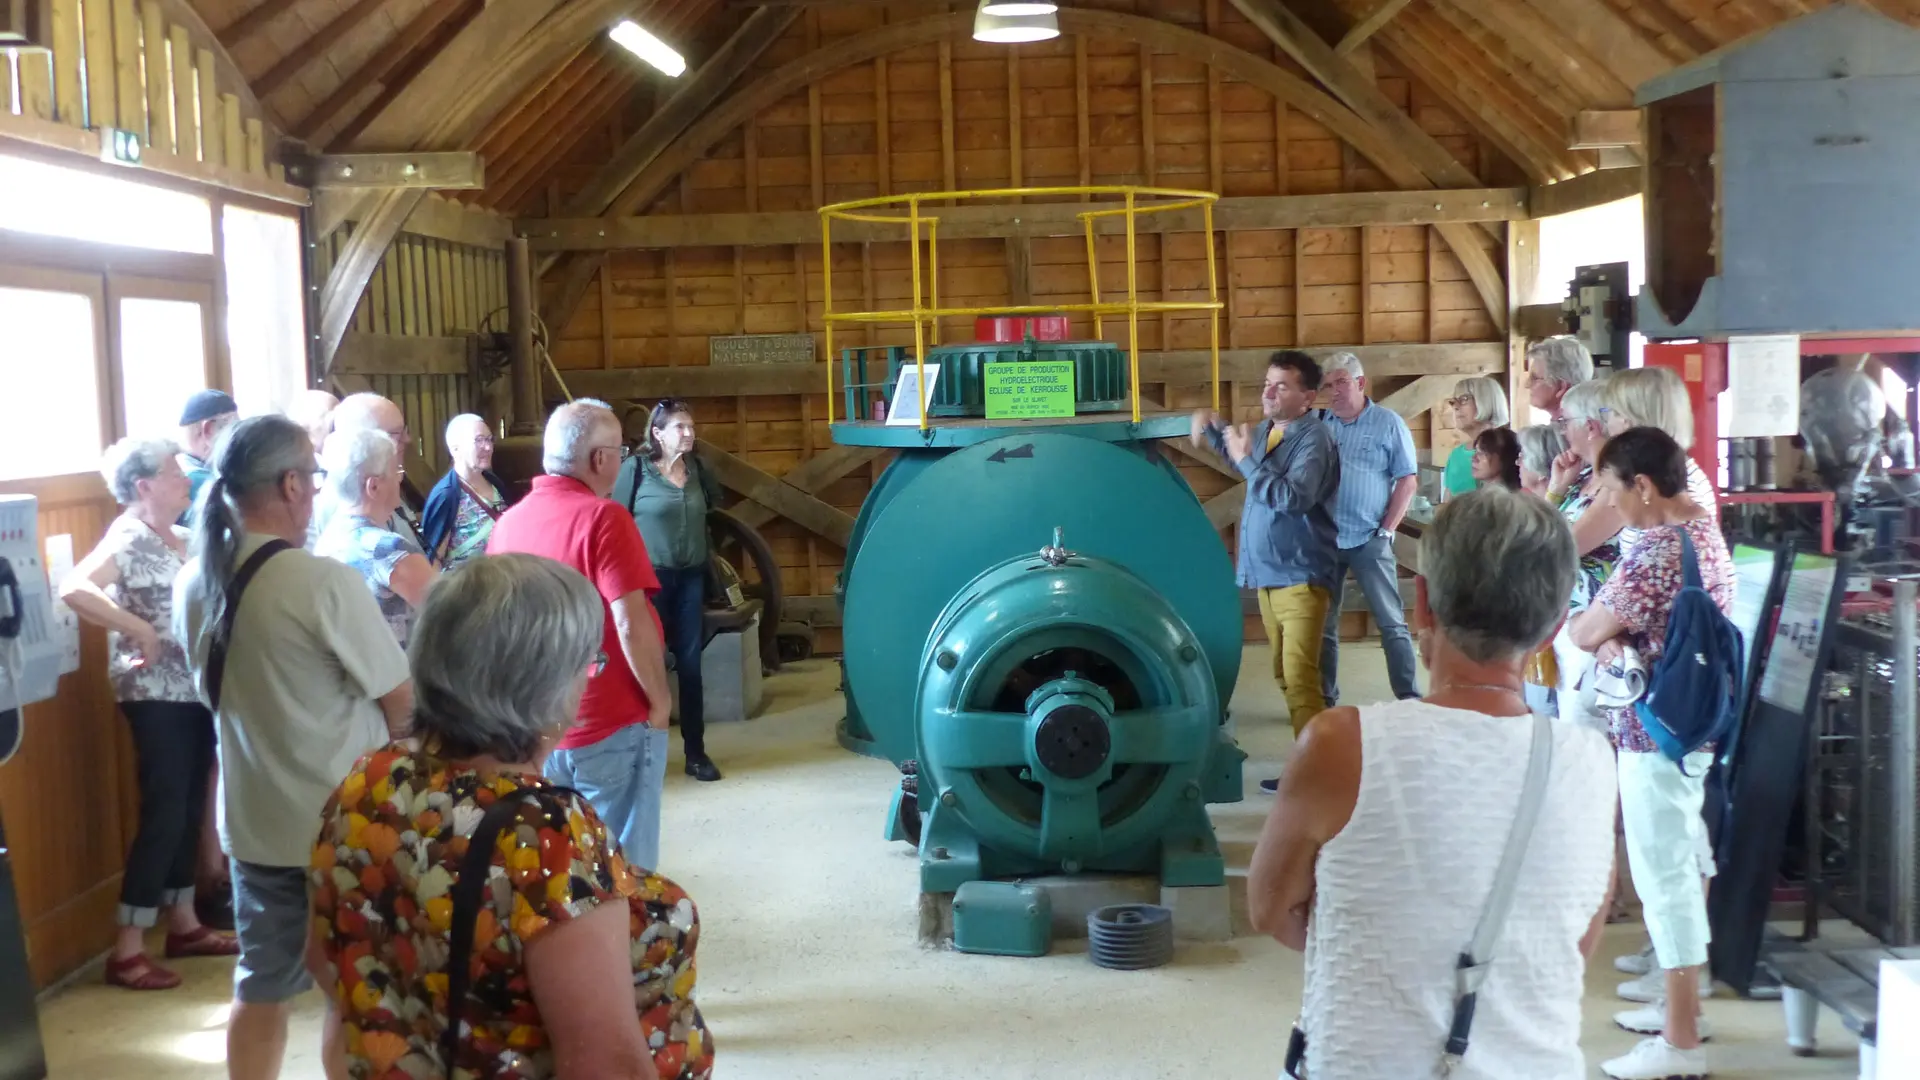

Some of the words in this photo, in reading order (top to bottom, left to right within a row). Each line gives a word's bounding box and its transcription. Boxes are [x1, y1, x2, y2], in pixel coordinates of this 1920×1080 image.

[714, 352, 757, 363] MAISON
[988, 366, 1013, 375] GROUPE
[1017, 366, 1026, 374] DE
[1030, 365, 1070, 374] PRODUCTION
[1000, 375, 1058, 384] HYDROELECTRIQUE
[989, 386, 1013, 395] ECLUSE
[1016, 386, 1026, 394] DE
[1030, 384, 1068, 393] KERROUSSE
